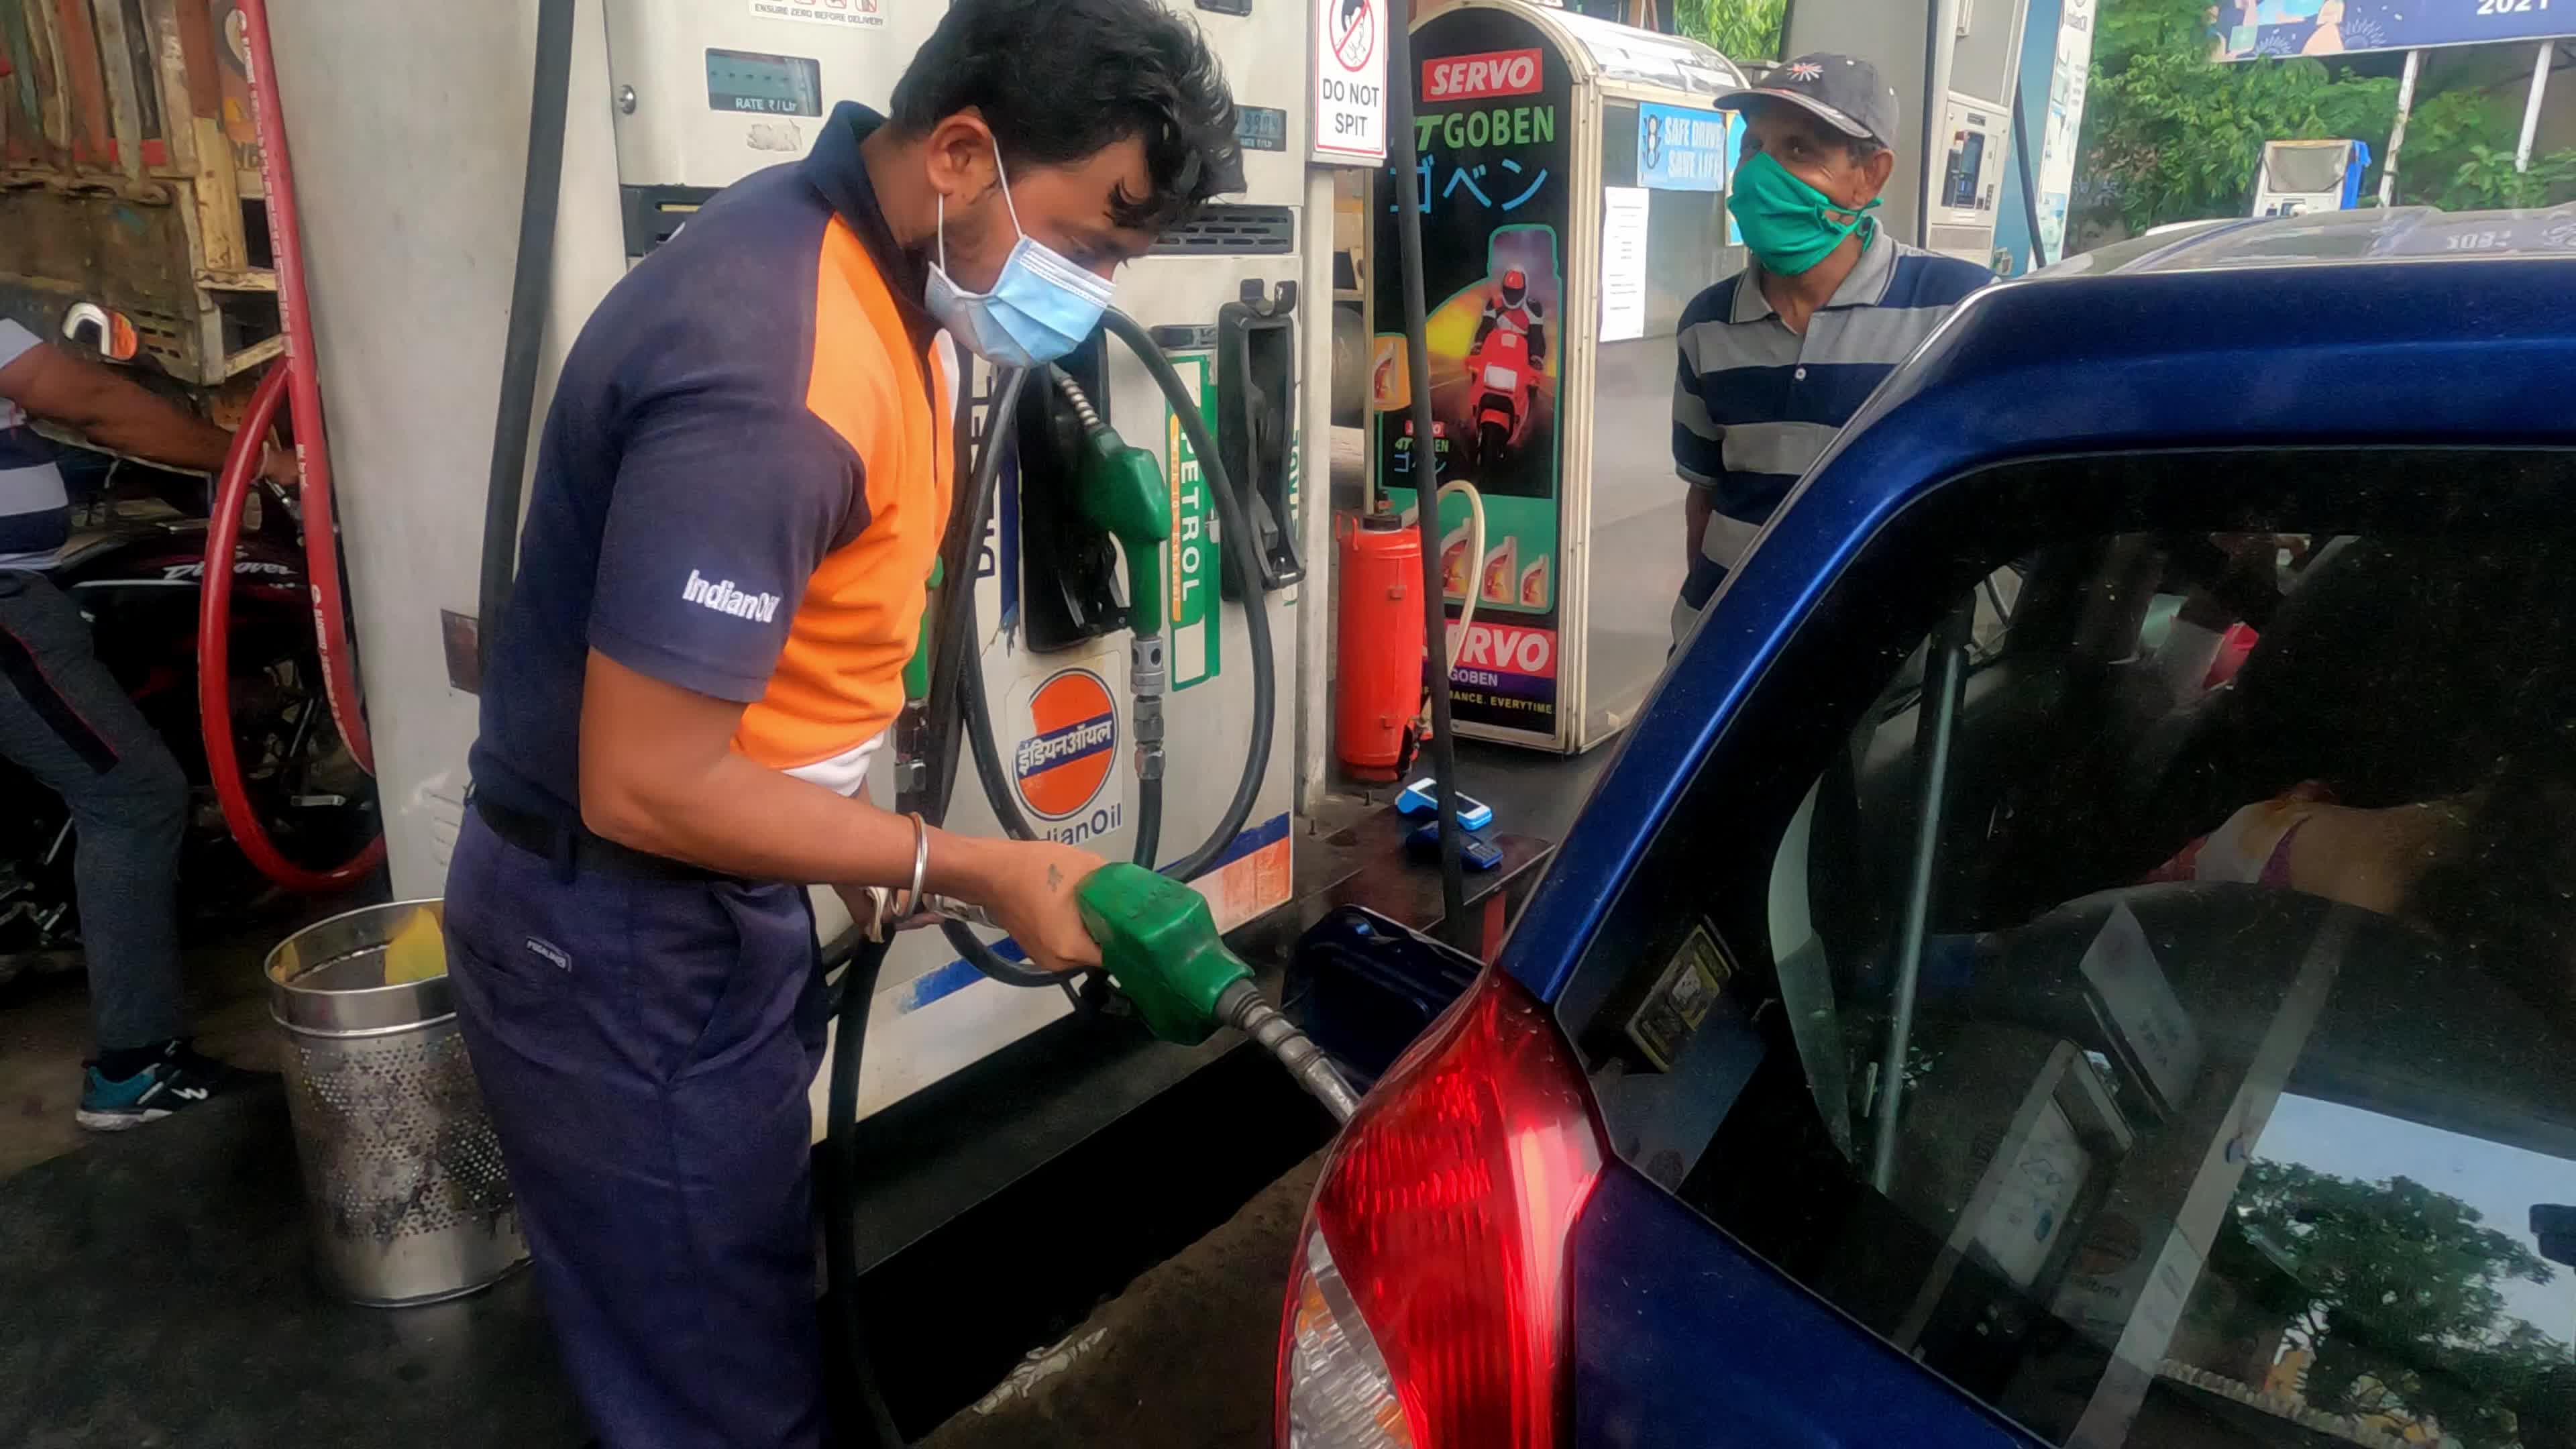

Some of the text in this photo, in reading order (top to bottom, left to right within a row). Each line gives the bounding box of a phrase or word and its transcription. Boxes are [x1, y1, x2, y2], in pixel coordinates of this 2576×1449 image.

[1430, 56, 1534, 95] SERVO
[735, 97, 764, 110] RATE
[1322, 78, 1380, 107] DO NOT
[1335, 113, 1368, 137] SPIT
[1414, 105, 1554, 151] T GOBEN
[1665, 116, 1691, 146] SAFE
[163, 561, 299, 580] Diover
[1449, 668, 1498, 687] GOBEN
[1018, 720, 1113, 775] इंडियनऑयल
